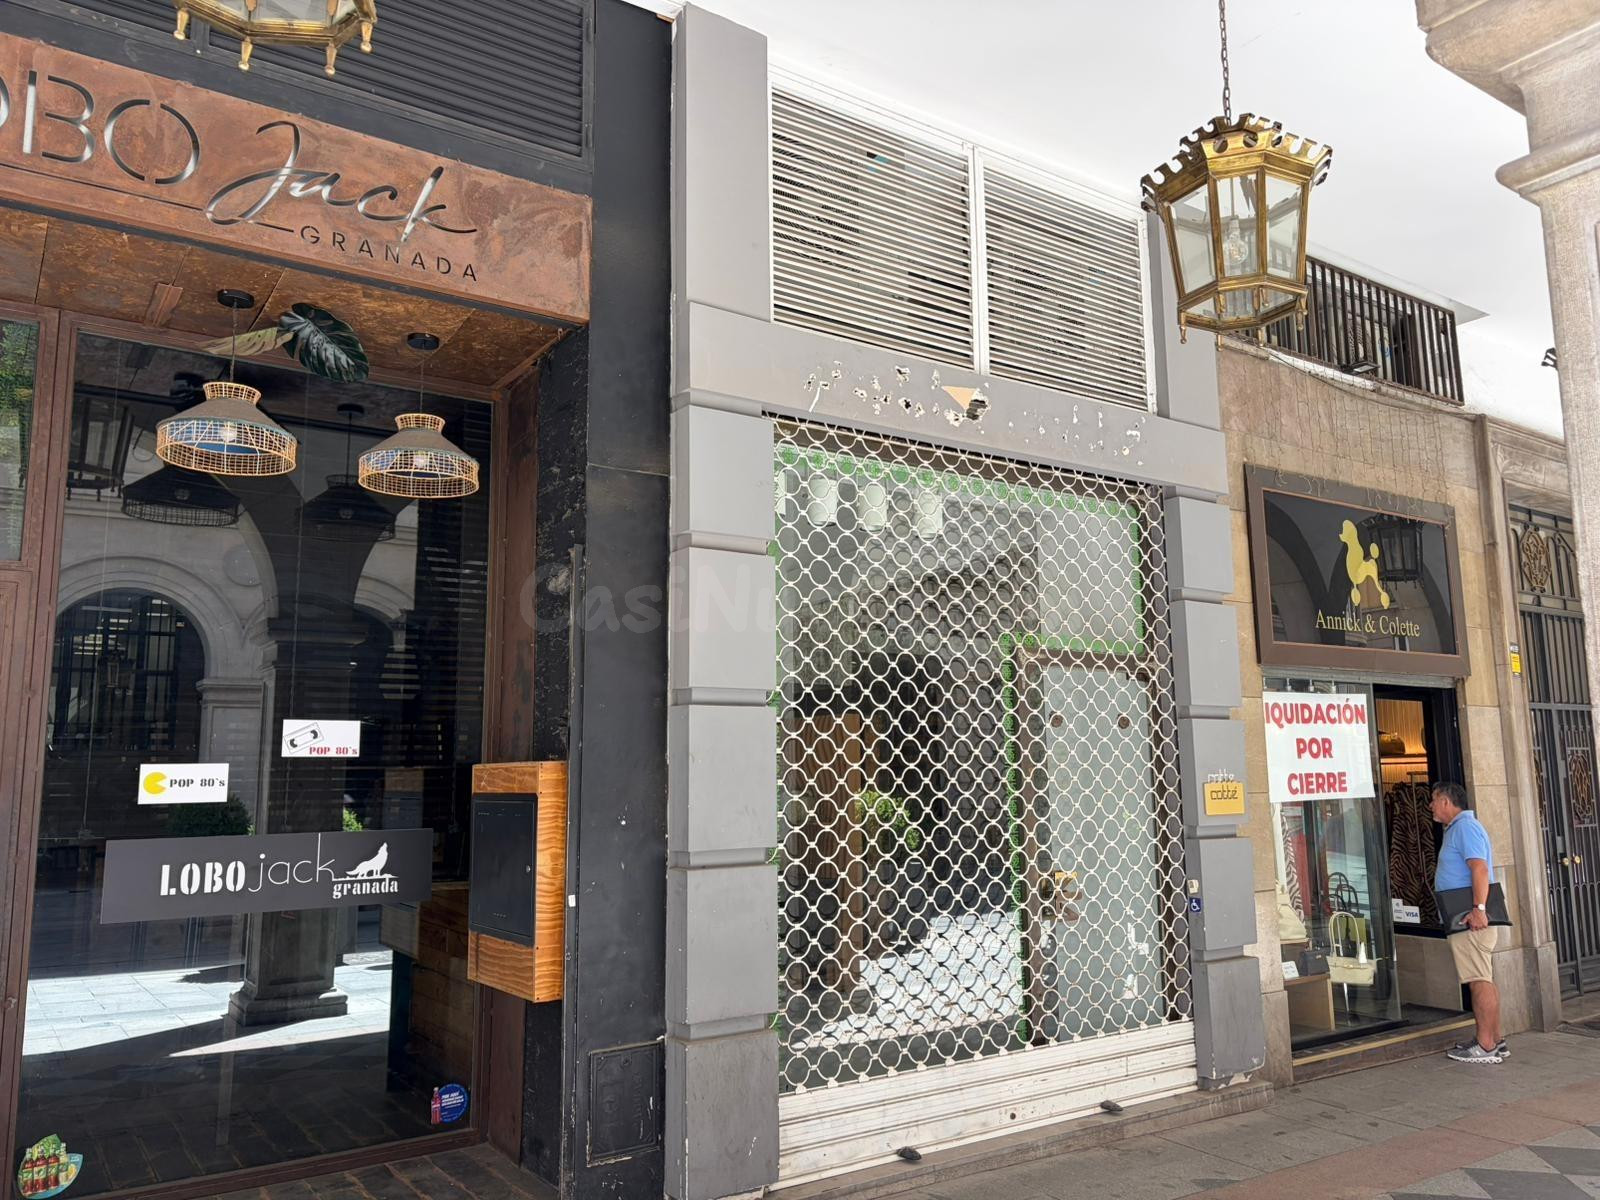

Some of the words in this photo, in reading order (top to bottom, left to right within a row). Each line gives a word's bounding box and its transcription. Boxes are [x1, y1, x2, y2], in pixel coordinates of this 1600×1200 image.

[0, 70, 200, 185] BO
[205, 120, 478, 243] Jack
[298, 225, 479, 283] GRANADA
[1315, 608, 1363, 633] Annick
[1364, 614, 1377, 633] &
[1379, 614, 1421, 638] Colette
[1264, 698, 1367, 729] IQUIDACIÓN
[309, 746, 330, 755] POP
[1296, 737, 1333, 759] POR
[169, 778, 194, 788] POP
[1287, 772, 1348, 795] CIERRE
[160, 860, 246, 897] LOBO
[248, 832, 334, 892] jack
[332, 876, 399, 900] granada
